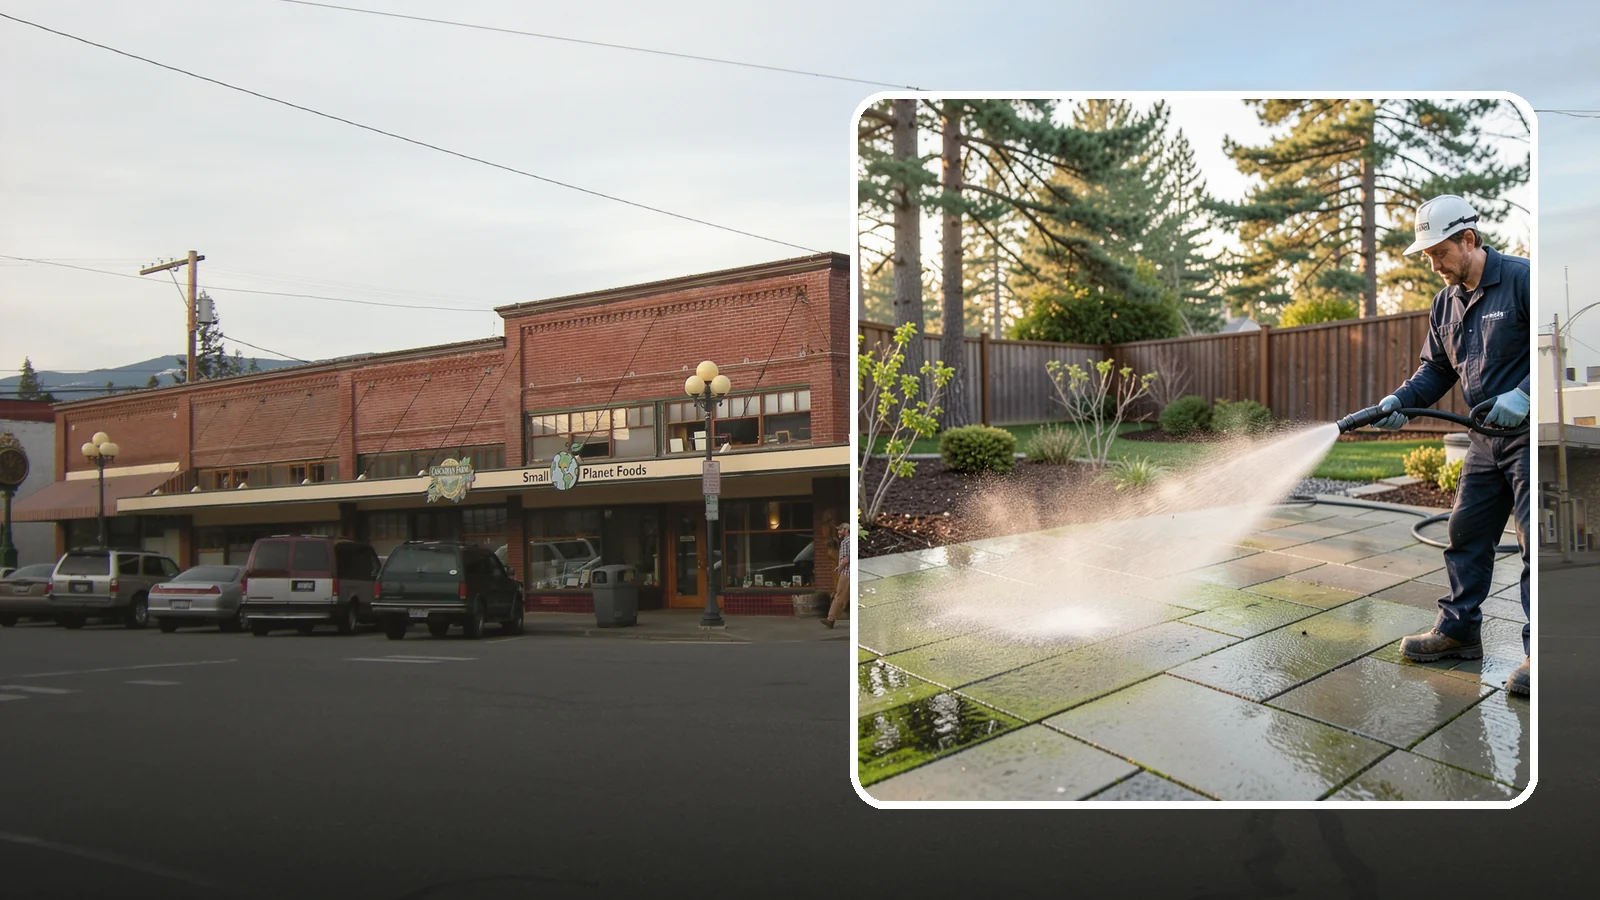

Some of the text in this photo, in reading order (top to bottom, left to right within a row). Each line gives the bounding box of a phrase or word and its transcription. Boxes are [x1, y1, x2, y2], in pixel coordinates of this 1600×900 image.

[523, 464, 647, 482] Small Planet Foods
